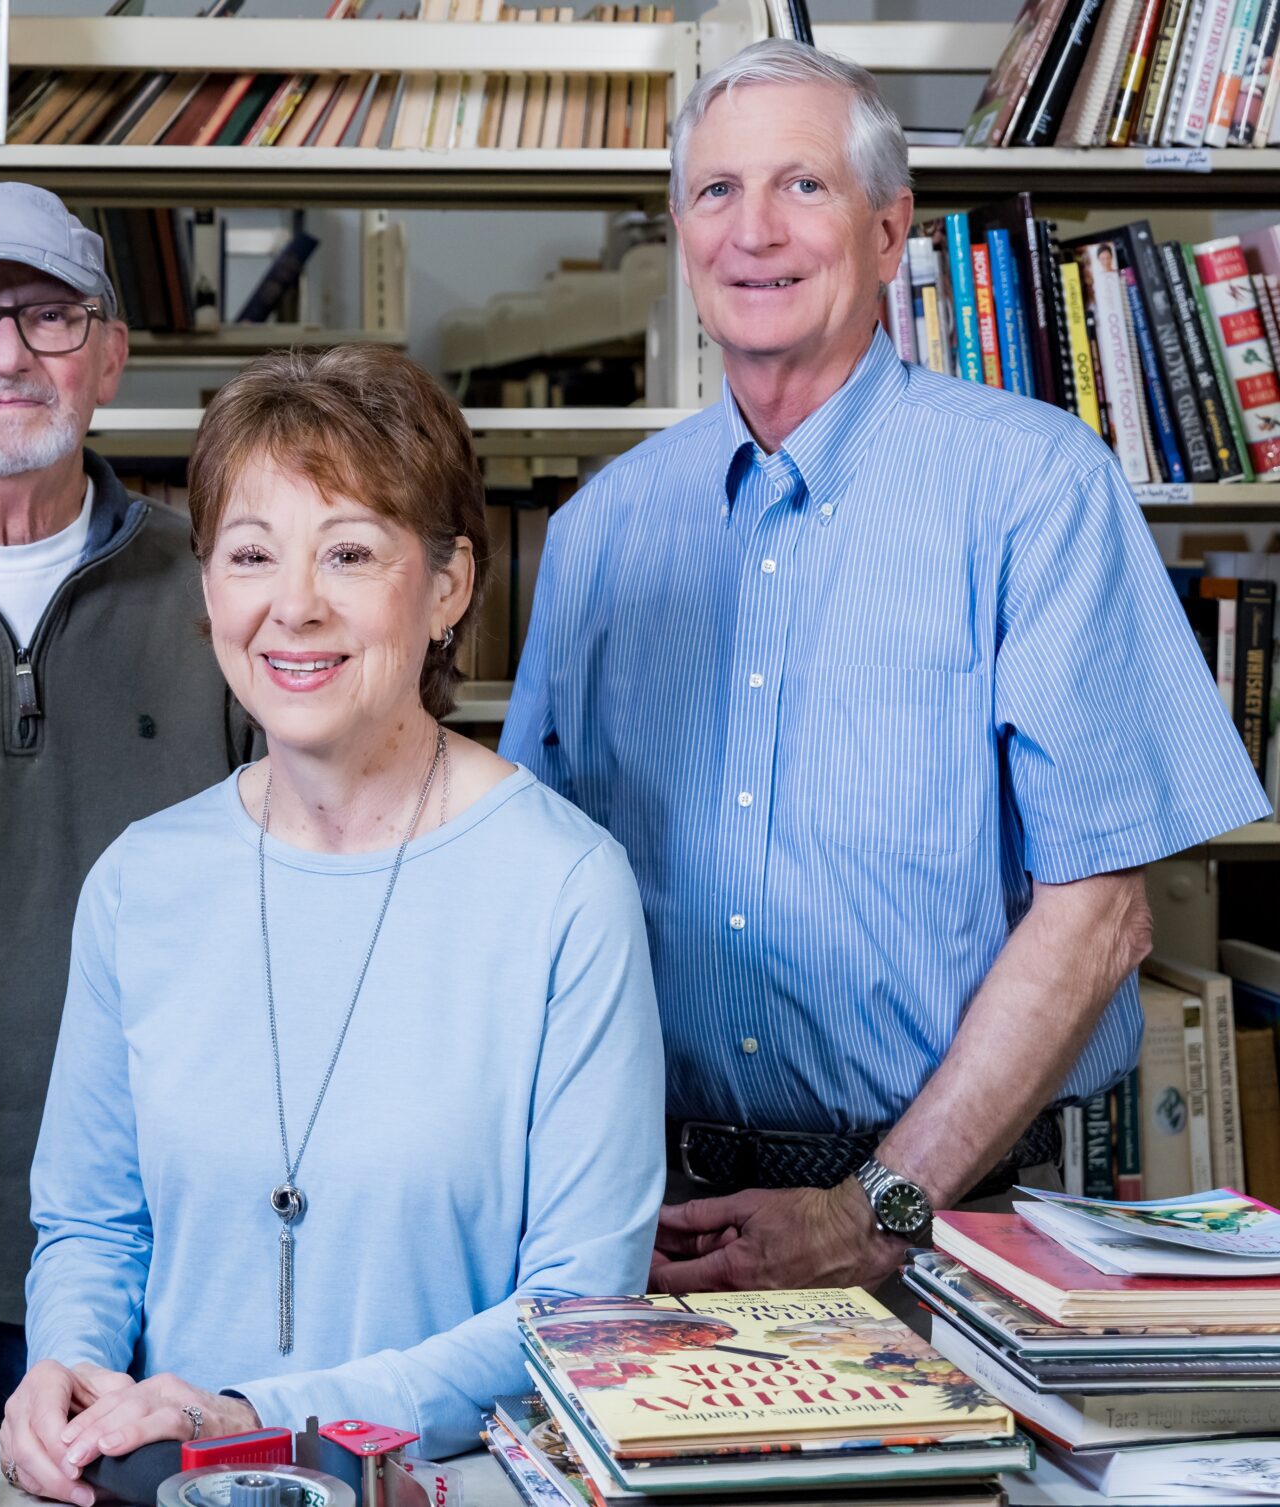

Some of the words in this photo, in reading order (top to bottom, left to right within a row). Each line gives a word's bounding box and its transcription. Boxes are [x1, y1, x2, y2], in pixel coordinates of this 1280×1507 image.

[973, 251, 987, 286] NOW
[1030, 251, 1042, 289] Chocolate
[977, 288, 990, 314] EAT
[1035, 289, 1046, 328] Cookbook
[980, 316, 995, 353] THIS!
[1173, 285, 1192, 320] kitchen
[1185, 321, 1203, 367] cookbook
[1007, 344, 1018, 369] Family
[1108, 313, 1131, 385] comfort
[1156, 323, 1186, 392] BACON
[985, 355, 998, 386] DIET
[1076, 352, 1092, 397] OOPS!
[1117, 388, 1141, 430] food
[1152, 380, 1171, 435] COOKBOOK
[1122, 431, 1141, 454] fix
[1179, 393, 1213, 474] BEYOND
[1244, 649, 1265, 716] WHISKEY
[1216, 995, 1227, 1014] THE
[1217, 1016, 1229, 1048] SILVER
[1219, 1051, 1232, 1087] PALATE
[1122, 1096, 1133, 1128] Heritage
[1221, 1089, 1235, 1145] COOKBOOK
[1086, 1120, 1109, 1170] BAKE
[1125, 1130, 1134, 1169] Cookbook
[740, 1308, 870, 1322] SPECIAL
[663, 1357, 823, 1378] BOOK
[677, 1371, 837, 1391] COOK
[629, 1385, 911, 1413] HOLIDAY
[748, 1408, 766, 1421] &
[770, 1405, 841, 1418] Homes
[843, 1401, 904, 1416] Better
[664, 1409, 749, 1424] Gardens
[1106, 1407, 1139, 1430] Tara
[1147, 1404, 1182, 1430] High
[1190, 1403, 1261, 1425] Resource
